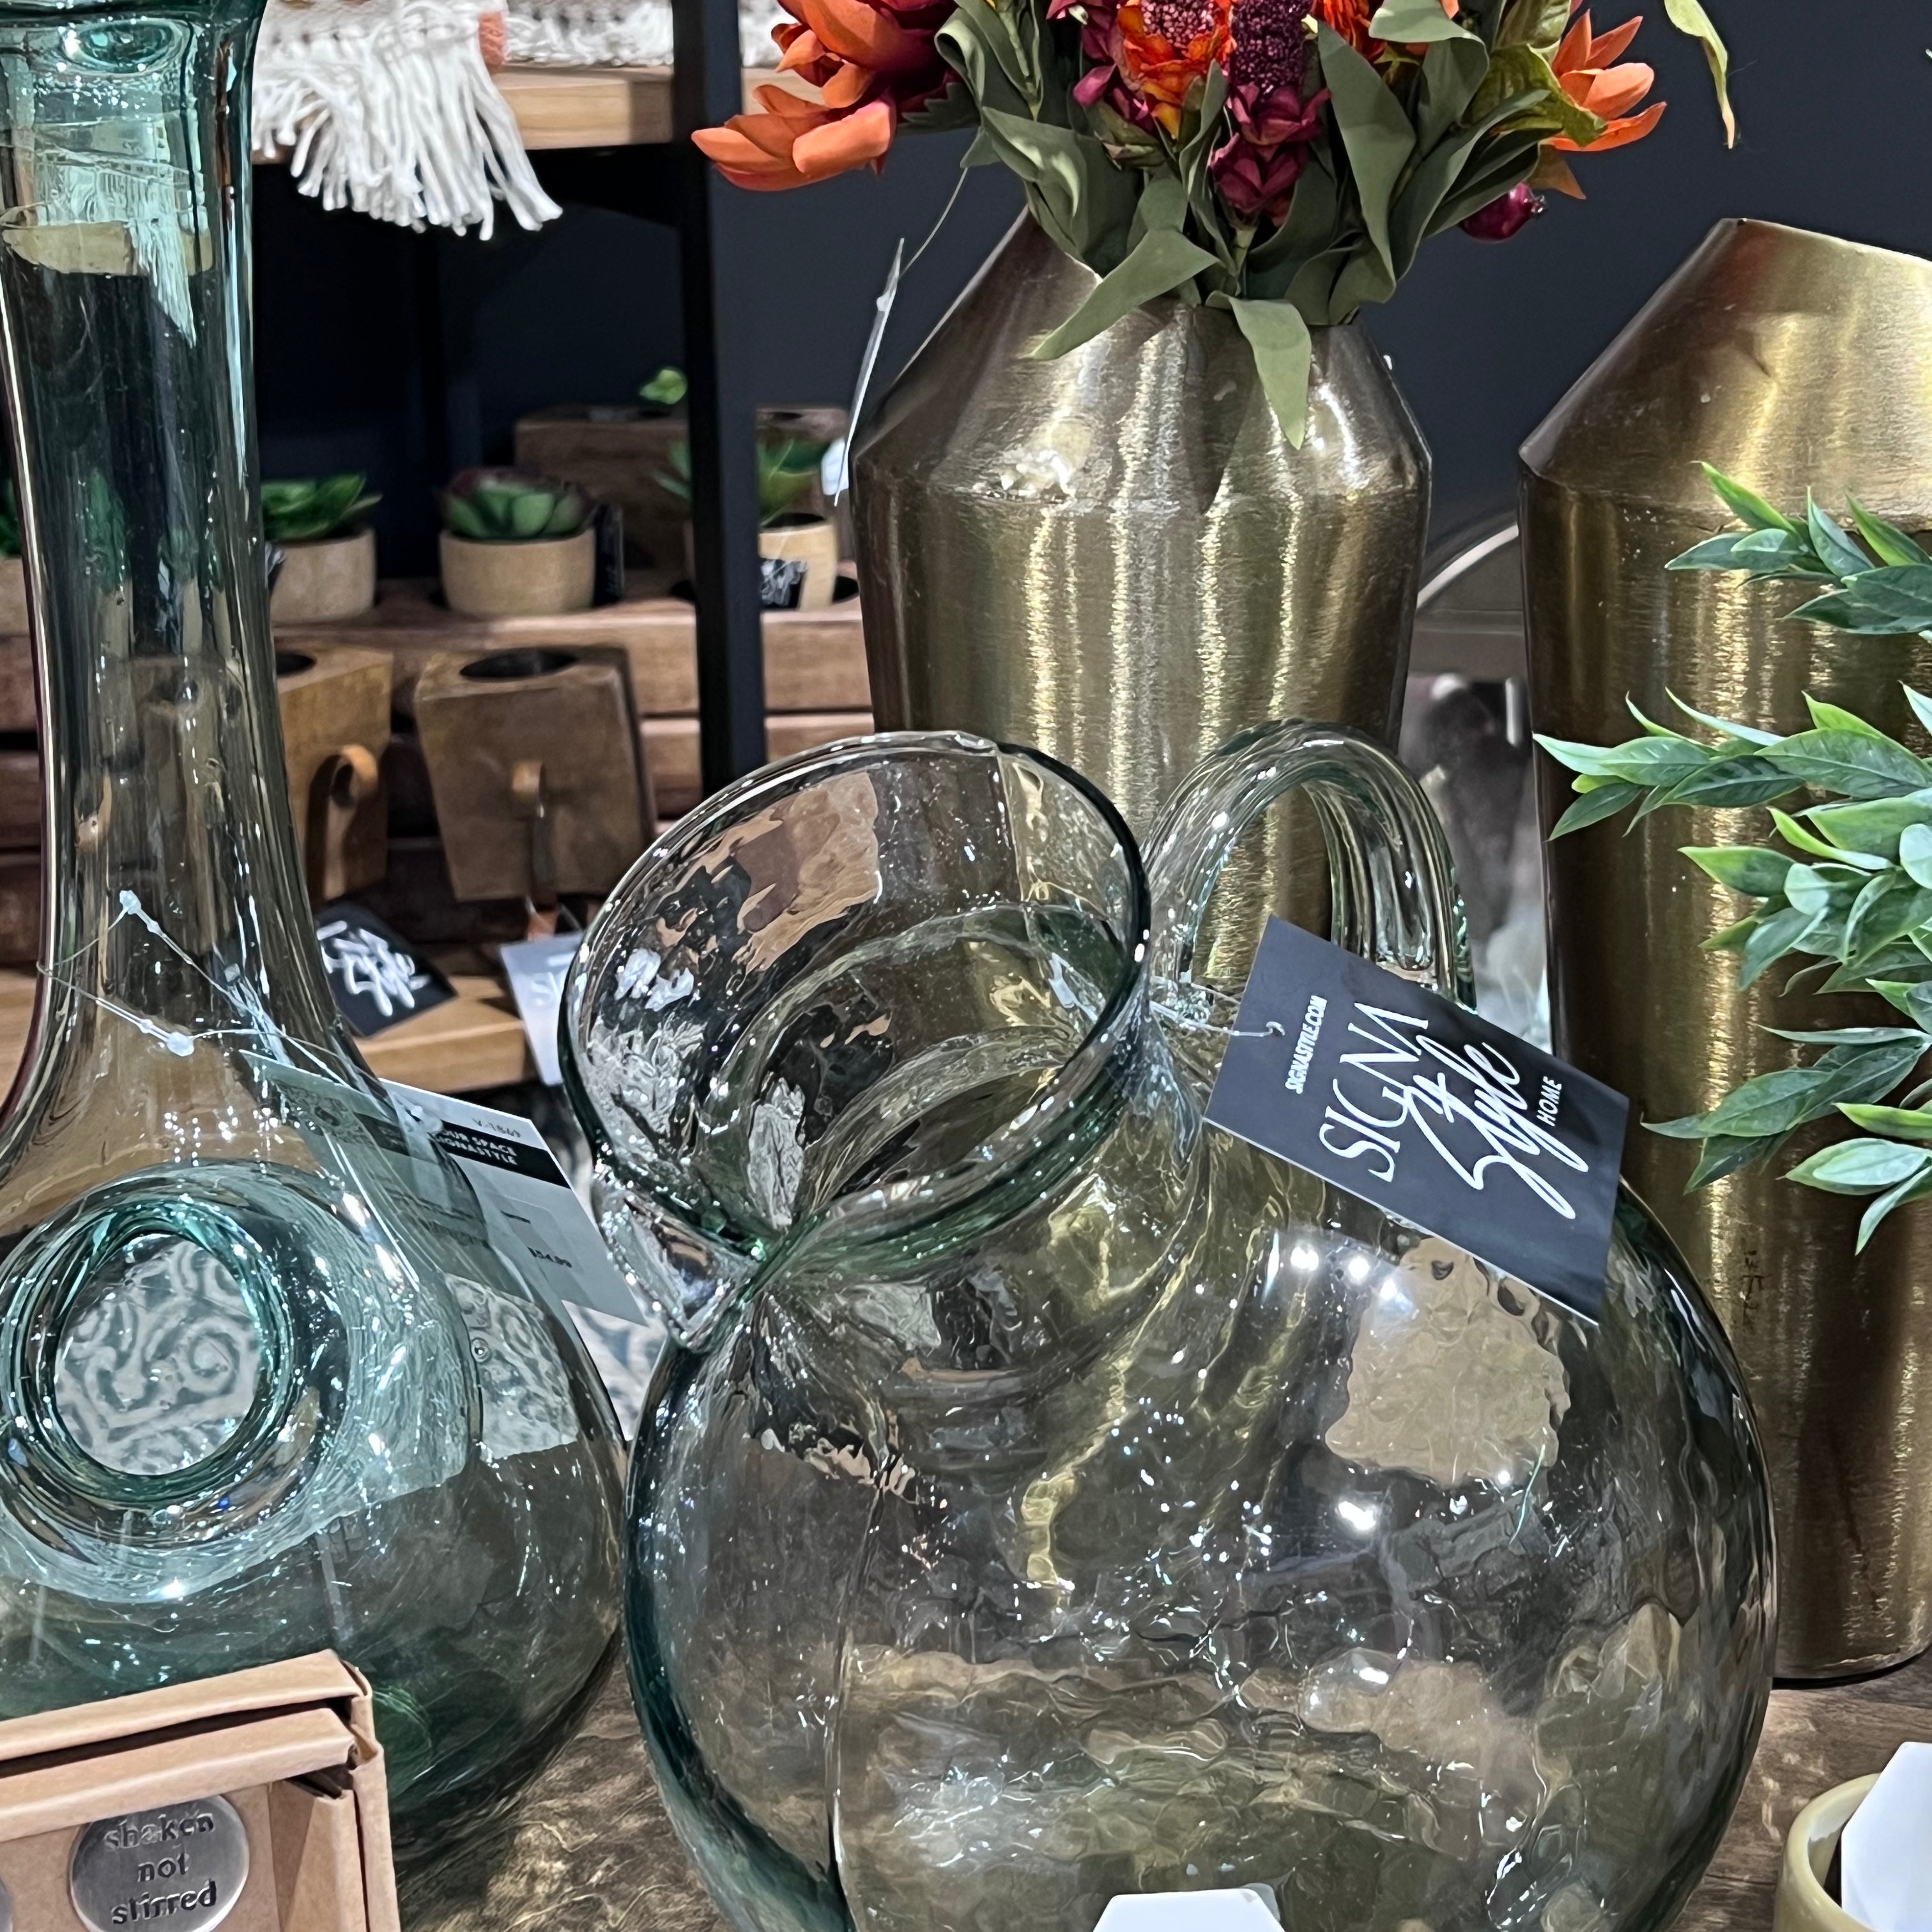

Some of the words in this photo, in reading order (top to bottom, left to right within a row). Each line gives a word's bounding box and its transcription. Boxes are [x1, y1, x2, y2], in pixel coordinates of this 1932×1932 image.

[1318, 1002, 1429, 1183] SIGNA
[1535, 1076, 1563, 1127] HOME
[471, 1137, 517, 1156] SPACE
[1406, 1034, 1589, 1219] Style
[103, 1813, 215, 1850] shaken
[137, 1850, 190, 1883] not
[110, 1878, 217, 1925] stirred
